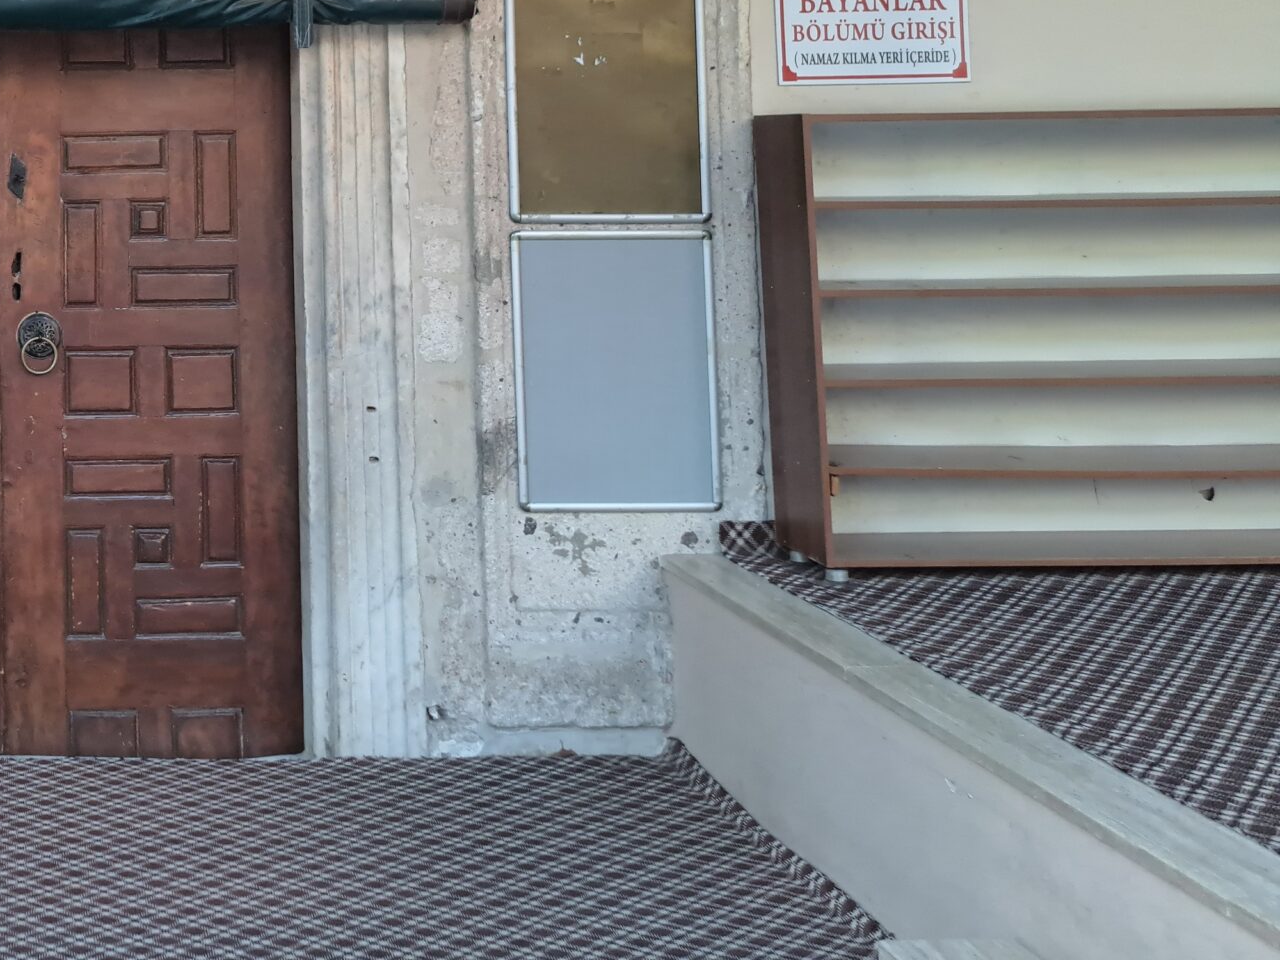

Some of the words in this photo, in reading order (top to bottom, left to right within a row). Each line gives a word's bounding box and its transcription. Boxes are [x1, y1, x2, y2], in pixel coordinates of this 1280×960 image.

[792, 18, 885, 42] BÖLÜMÜ
[891, 17, 956, 45] GİRİŞİ
[801, 53, 839, 65] NAMAZ
[843, 52, 876, 64] KILMA
[879, 48, 903, 64] YERİ
[906, 48, 949, 67] İÇERİDE
